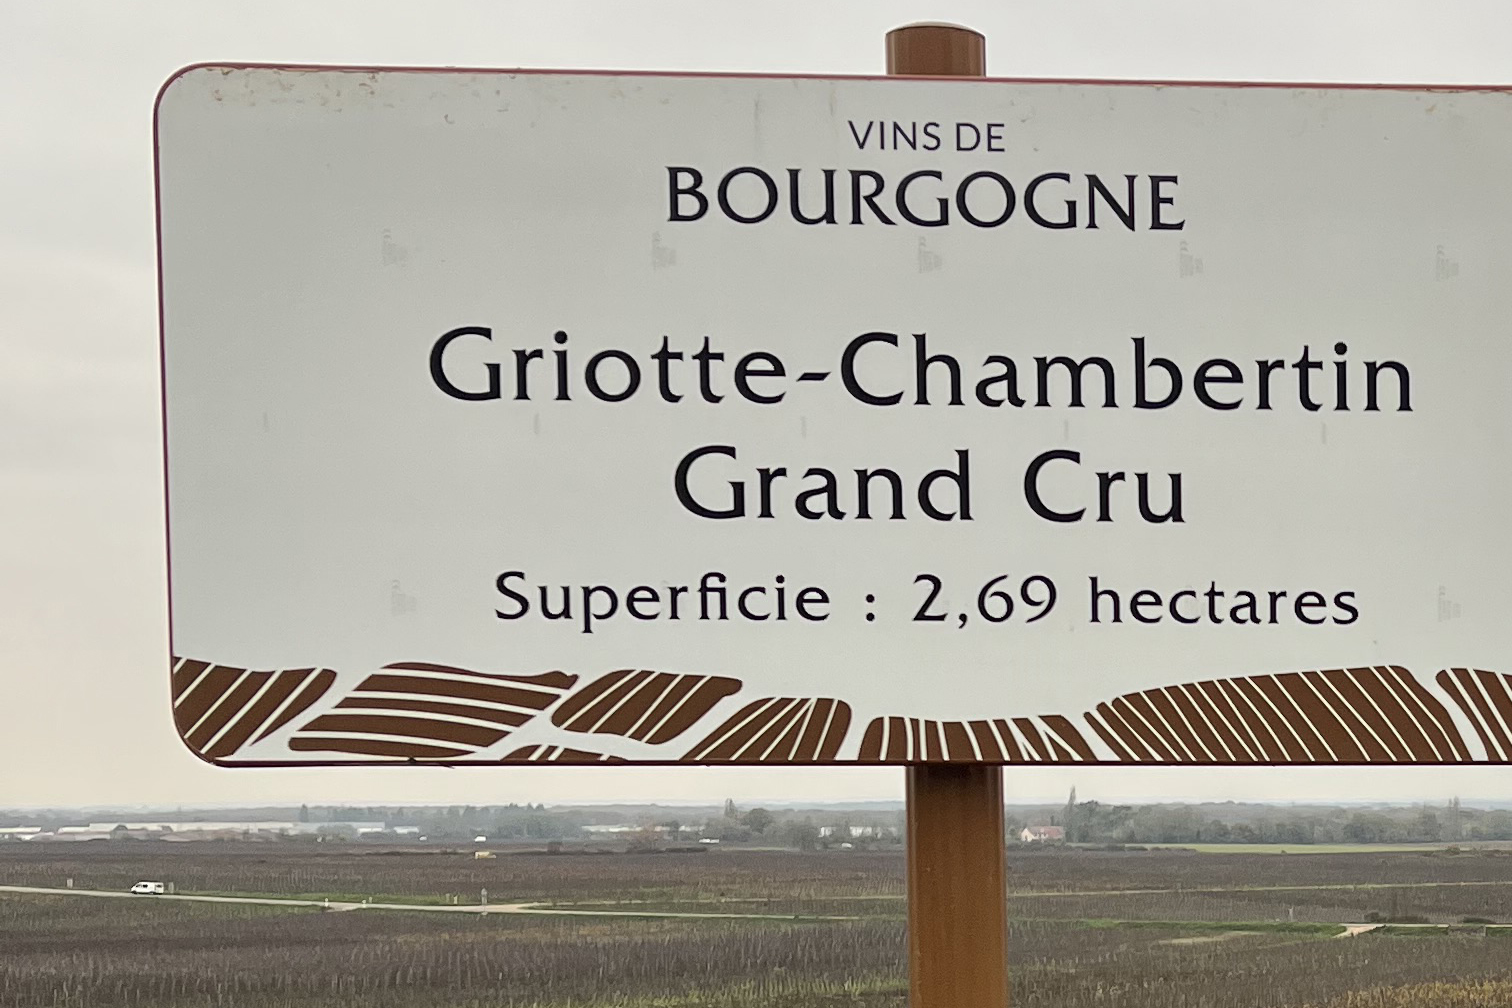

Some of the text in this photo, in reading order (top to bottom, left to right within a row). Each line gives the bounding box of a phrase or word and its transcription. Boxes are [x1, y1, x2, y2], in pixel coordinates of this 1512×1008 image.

[848, 121, 1006, 152] VINS DE
[667, 167, 1185, 231] BOURGOGNE
[430, 327, 1413, 411] Griotte-Chambertin
[675, 446, 1184, 523] Grand Cru
[496, 571, 829, 633] Superficie
[913, 574, 1057, 628] 2,69
[1089, 577, 1359, 624] hectares
